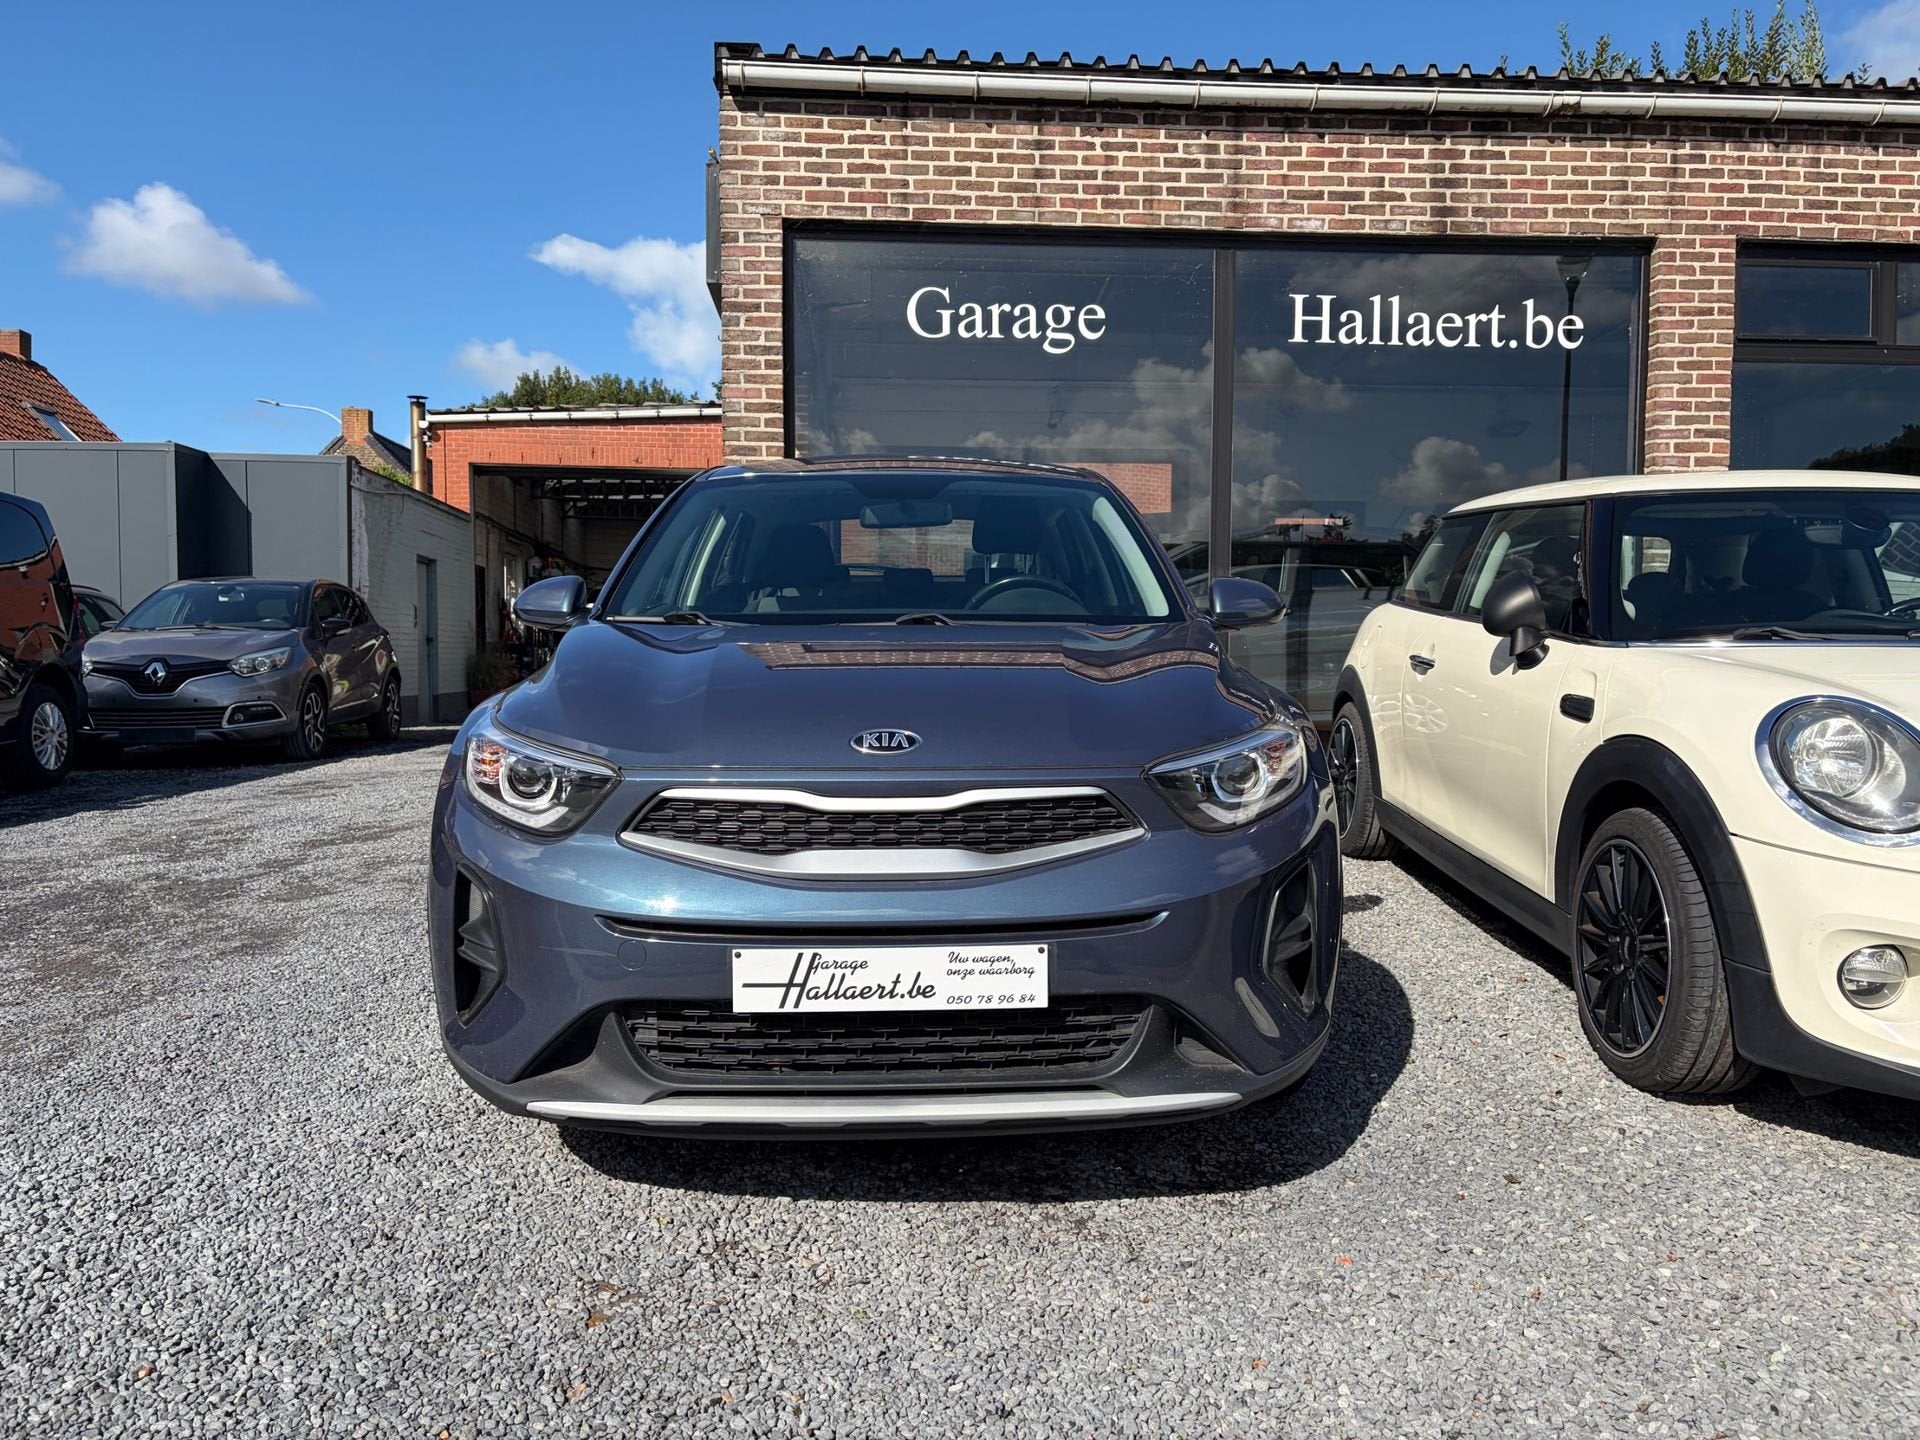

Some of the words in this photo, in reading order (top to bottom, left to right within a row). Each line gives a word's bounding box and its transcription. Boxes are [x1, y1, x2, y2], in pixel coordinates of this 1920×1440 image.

[906, 286, 1107, 355] Garage
[1287, 293, 1585, 350] Hallaert.be
[863, 733, 909, 747] KIA
[811, 952, 869, 976] Garage
[948, 951, 969, 964] Uw
[972, 955, 1015, 967] wagen,
[946, 968, 975, 980] onze
[979, 962, 1036, 979] waarborg
[742, 952, 936, 1009] Hallaert.be
[946, 995, 973, 1005] 050
[977, 994, 994, 1004] 78
[998, 993, 1015, 1005] 96
[1018, 993, 1036, 1003] 84
